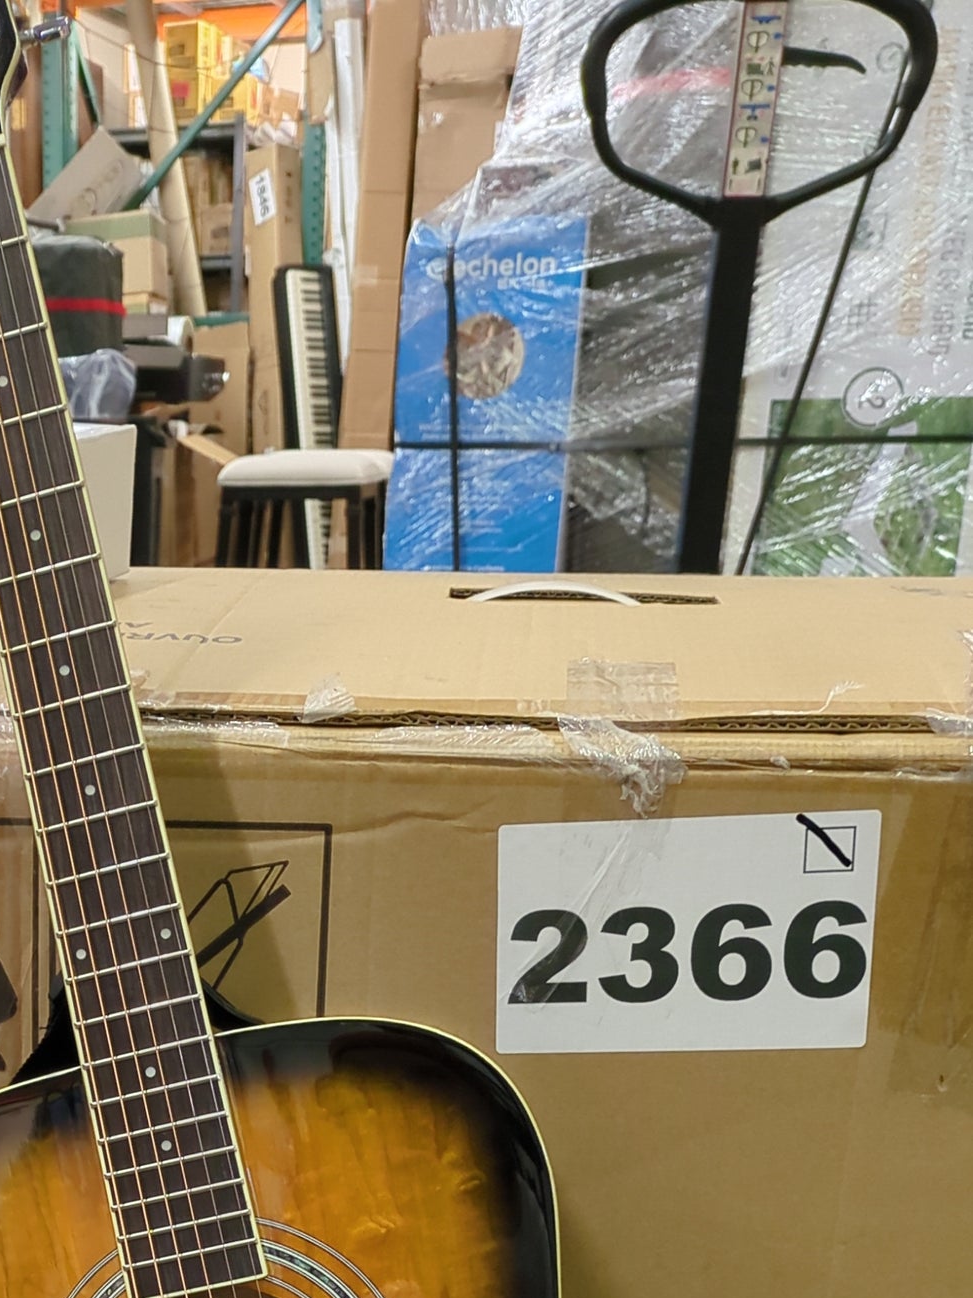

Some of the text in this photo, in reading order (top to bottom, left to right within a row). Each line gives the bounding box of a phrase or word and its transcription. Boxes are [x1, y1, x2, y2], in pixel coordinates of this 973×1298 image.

[454, 252, 557, 278] echelon
[121, 632, 243, 644] OUVR
[508, 900, 868, 1005] 2366
